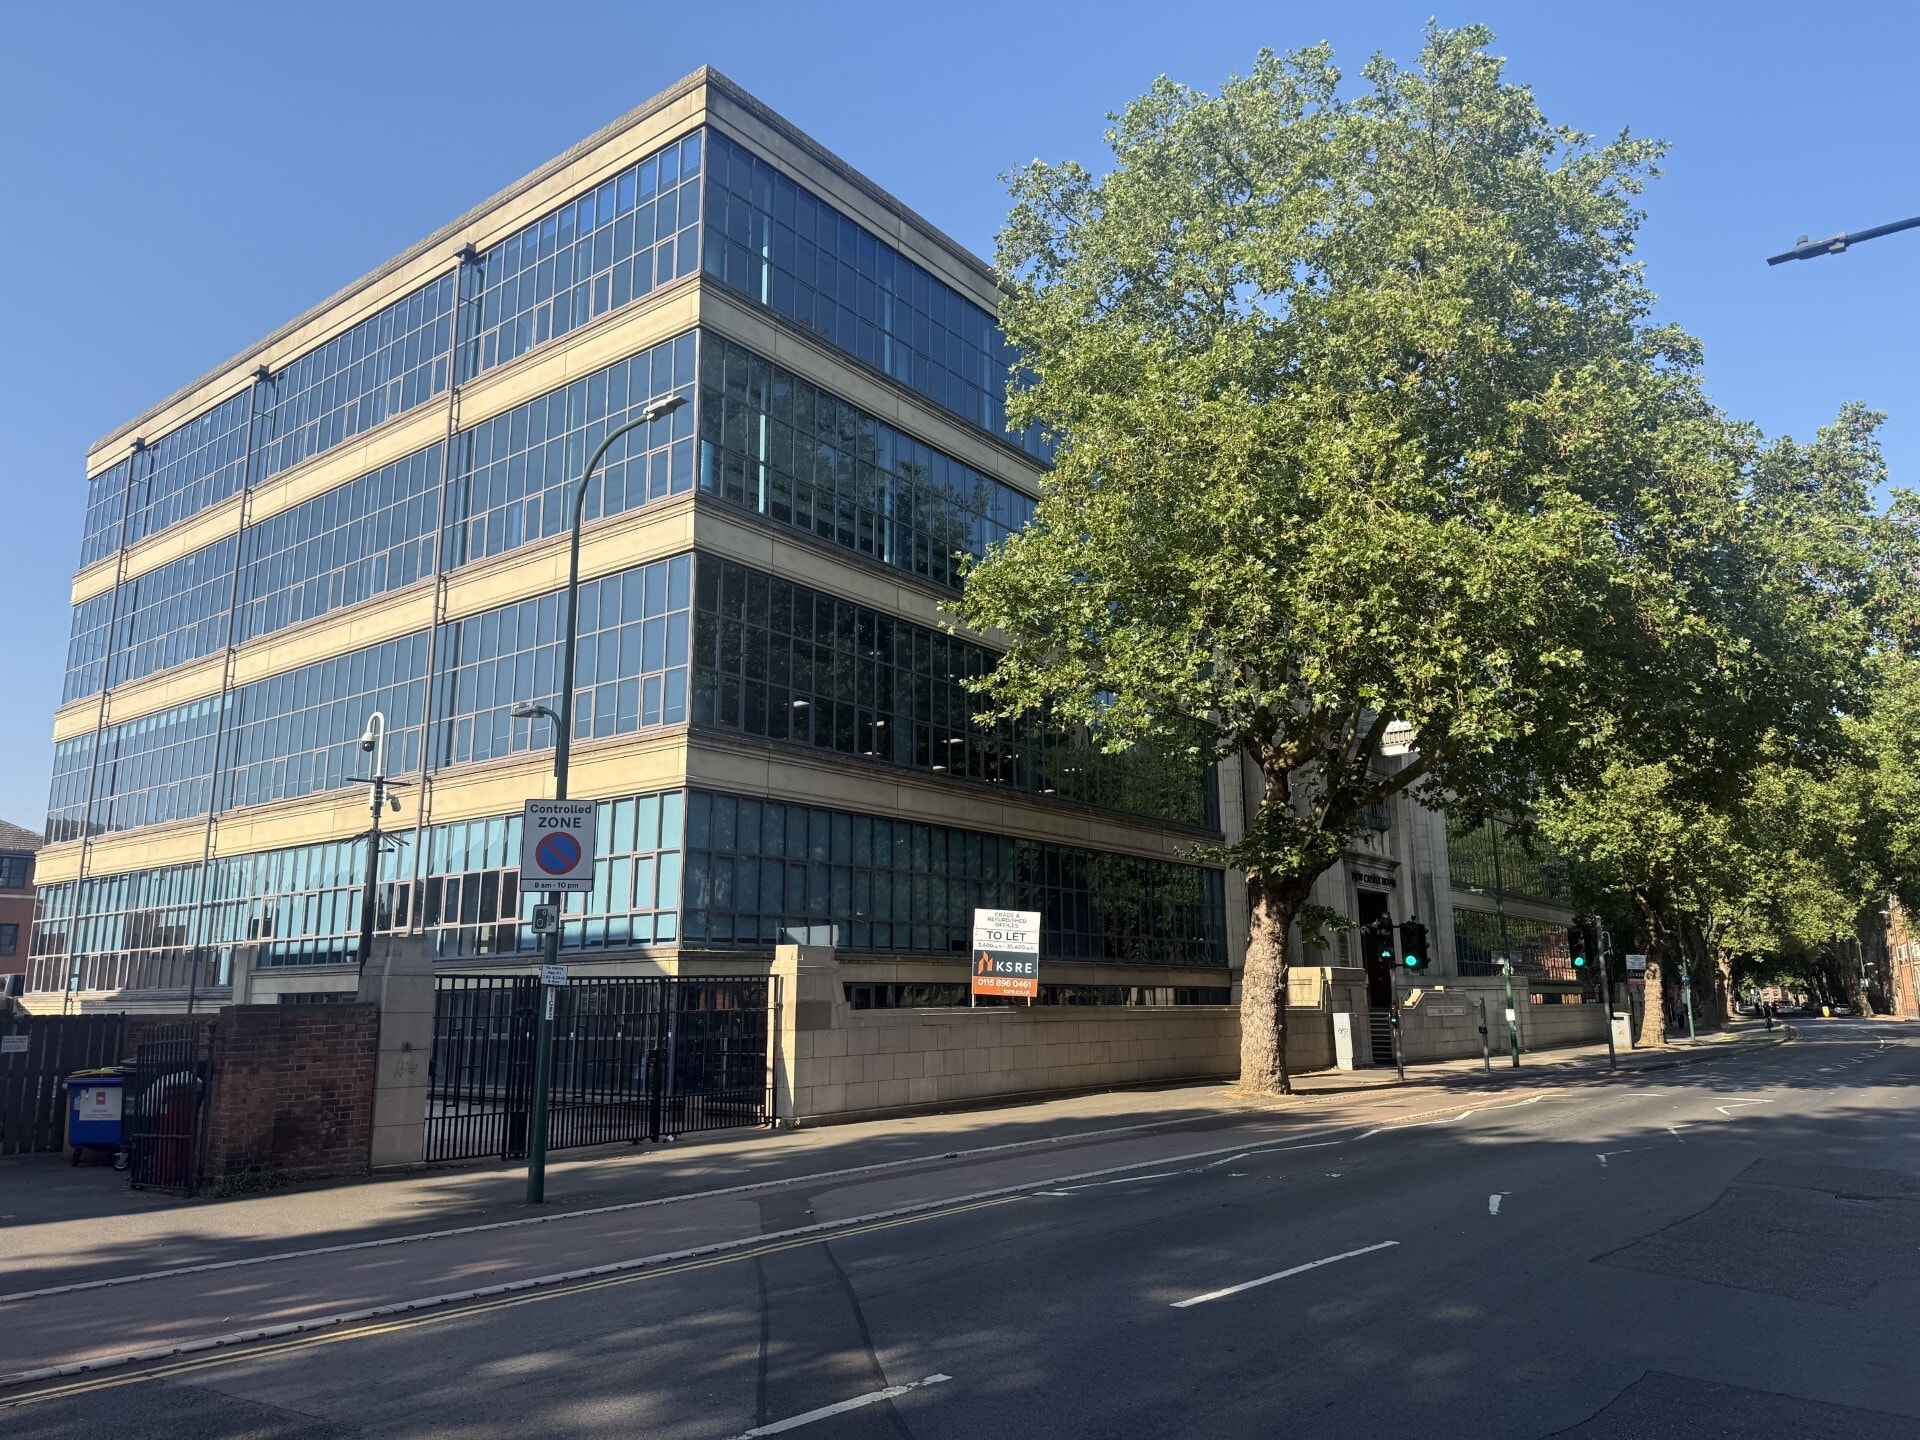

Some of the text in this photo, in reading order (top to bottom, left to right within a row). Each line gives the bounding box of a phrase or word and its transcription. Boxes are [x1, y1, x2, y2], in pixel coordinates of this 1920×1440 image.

[530, 804, 592, 814] Controlled
[538, 816, 582, 829] ZONE
[986, 930, 1027, 941] TO LET
[996, 960, 1033, 974] KSRE
[977, 978, 995, 986] 0115
[995, 980, 1012, 988] 896
